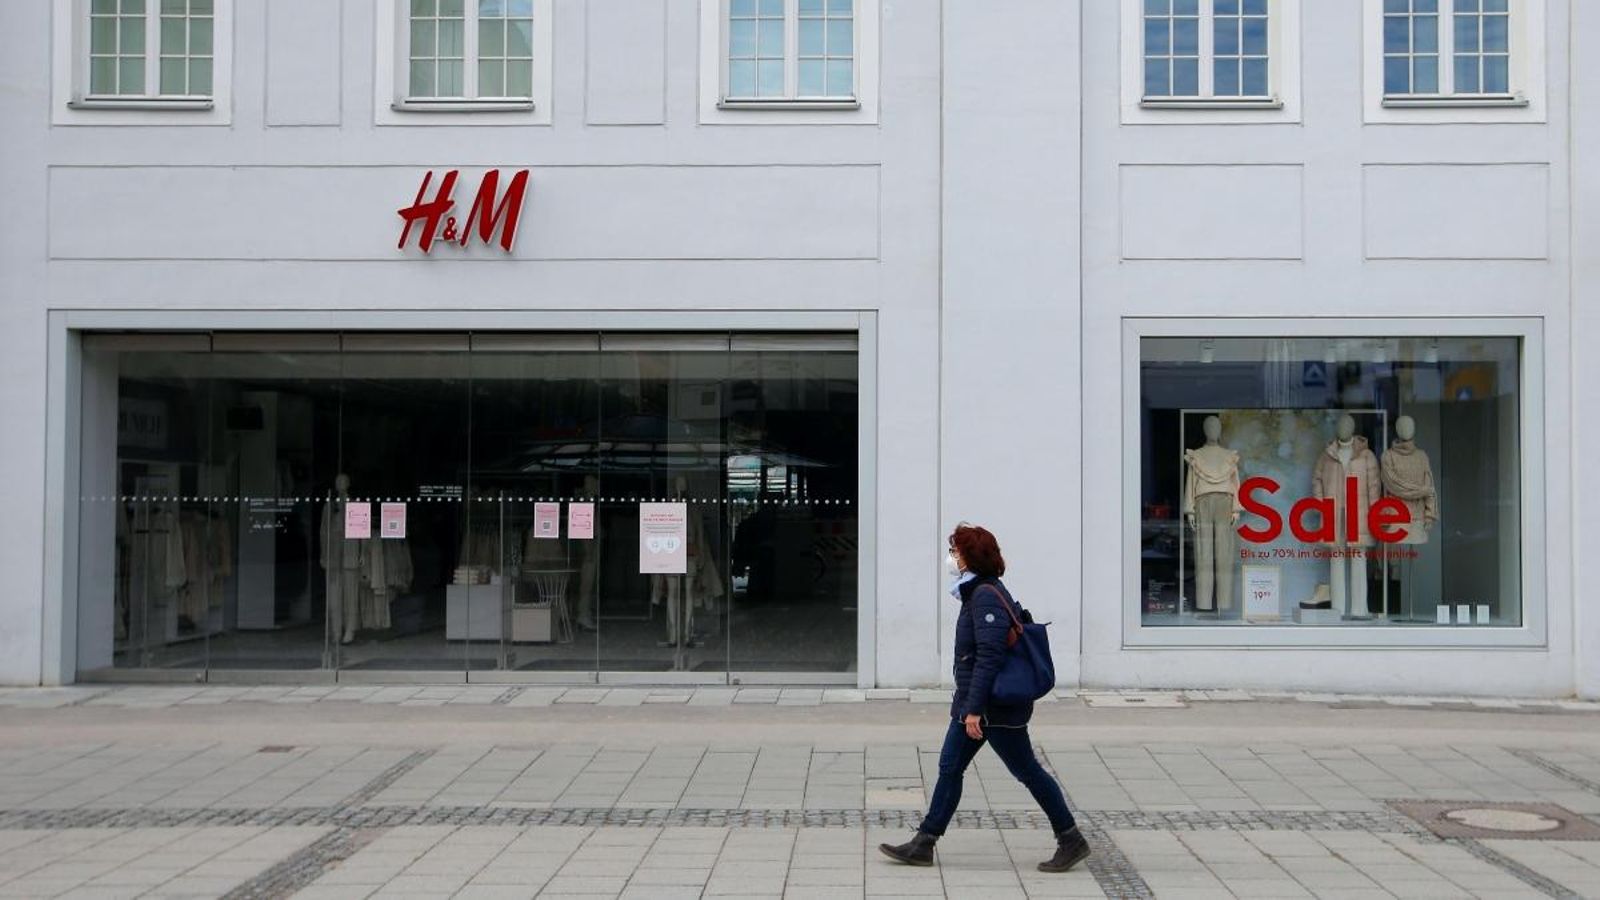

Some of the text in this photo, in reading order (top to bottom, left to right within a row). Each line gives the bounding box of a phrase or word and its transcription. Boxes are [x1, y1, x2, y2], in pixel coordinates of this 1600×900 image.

[397, 168, 531, 254] H&M
[1236, 475, 1412, 544] Sale
[1240, 549, 1256, 559] Bis
[1272, 548, 1296, 559] 70%
[1297, 549, 1310, 558] im
